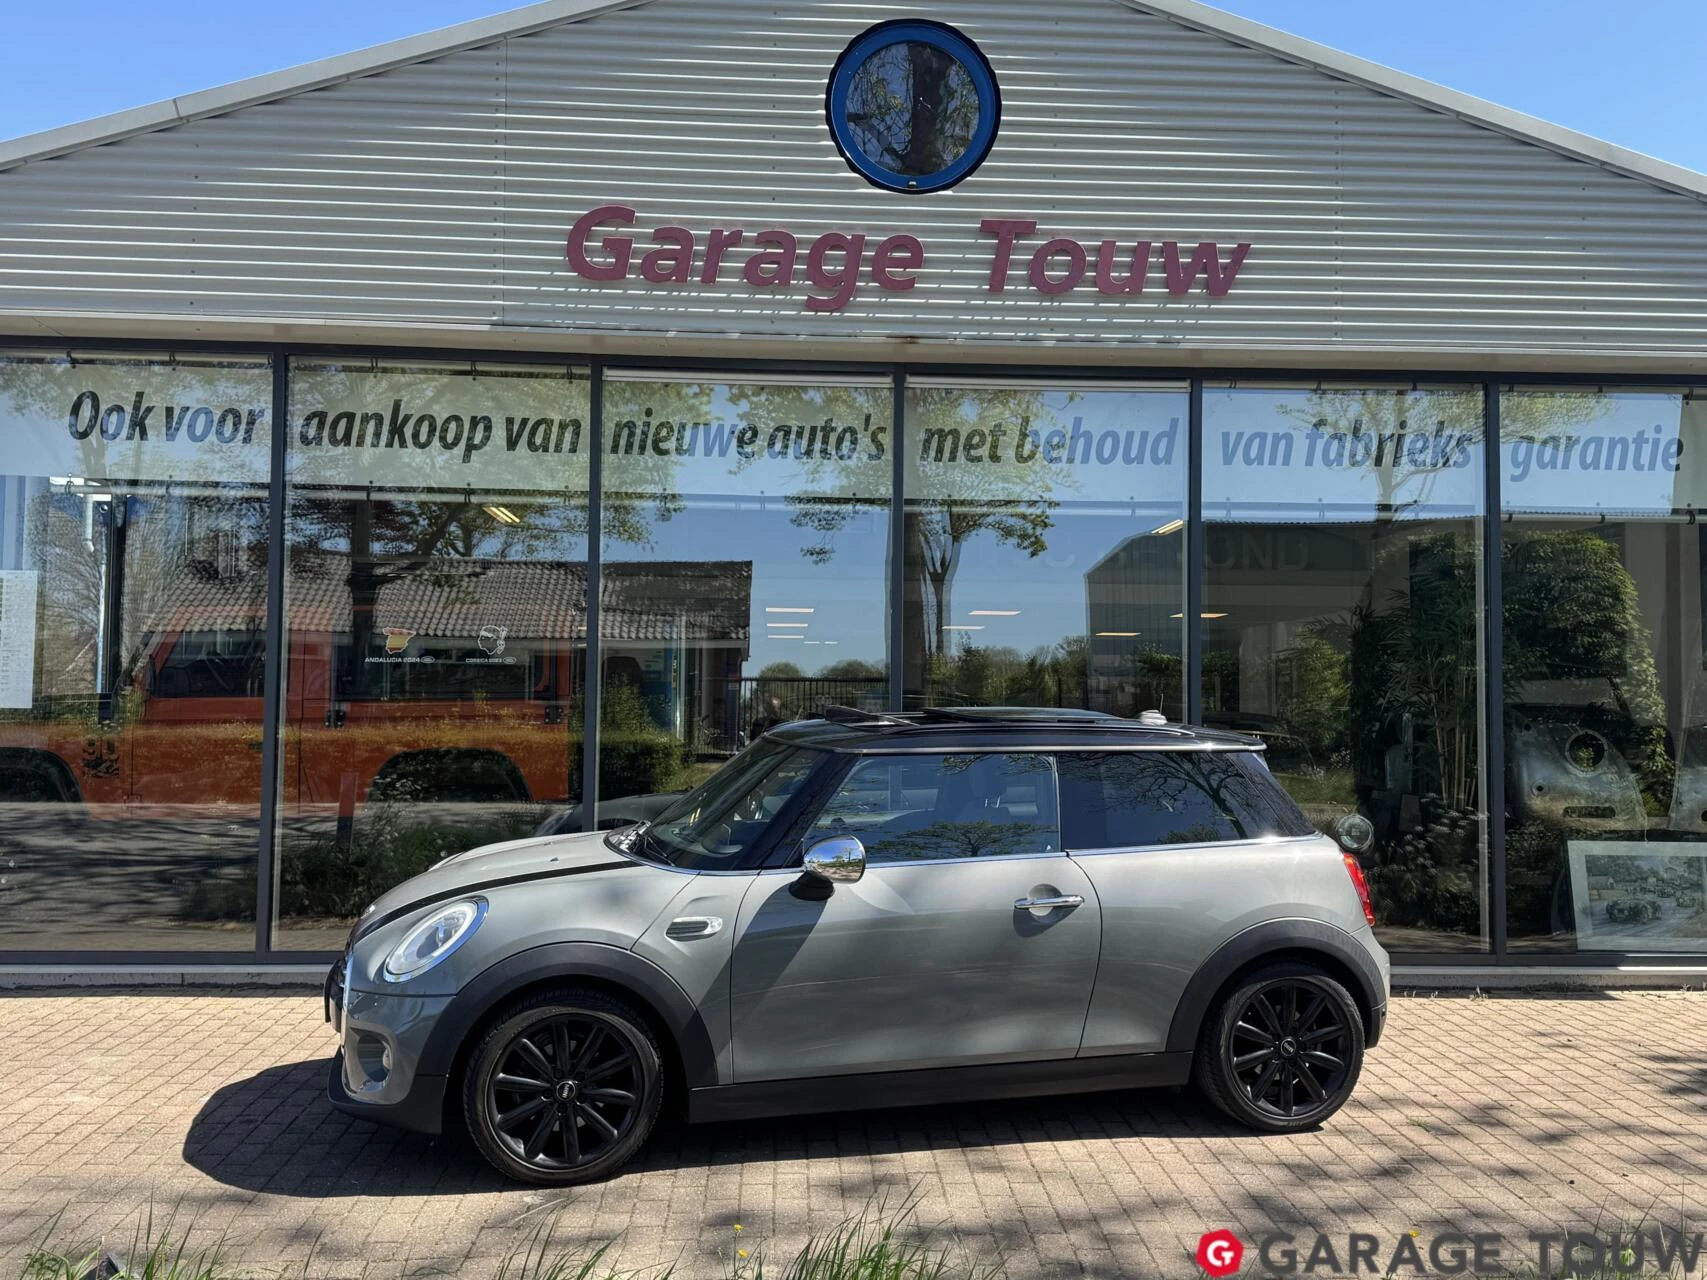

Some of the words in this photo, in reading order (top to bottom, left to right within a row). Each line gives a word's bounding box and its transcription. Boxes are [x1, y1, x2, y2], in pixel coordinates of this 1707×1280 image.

[565, 205, 925, 313] Garage
[980, 219, 1252, 298] Touw
[69, 390, 155, 442] Ook
[164, 405, 266, 446] voor
[300, 400, 494, 463] aankoop
[505, 415, 582, 454] van
[610, 407, 759, 459] nieuwe
[768, 414, 888, 462] auto's
[919, 420, 1008, 464] met
[1014, 415, 1180, 467] behoud
[1220, 429, 1295, 468] van
[1304, 418, 1473, 470] fabrieks
[1509, 424, 1684, 482] garantie
